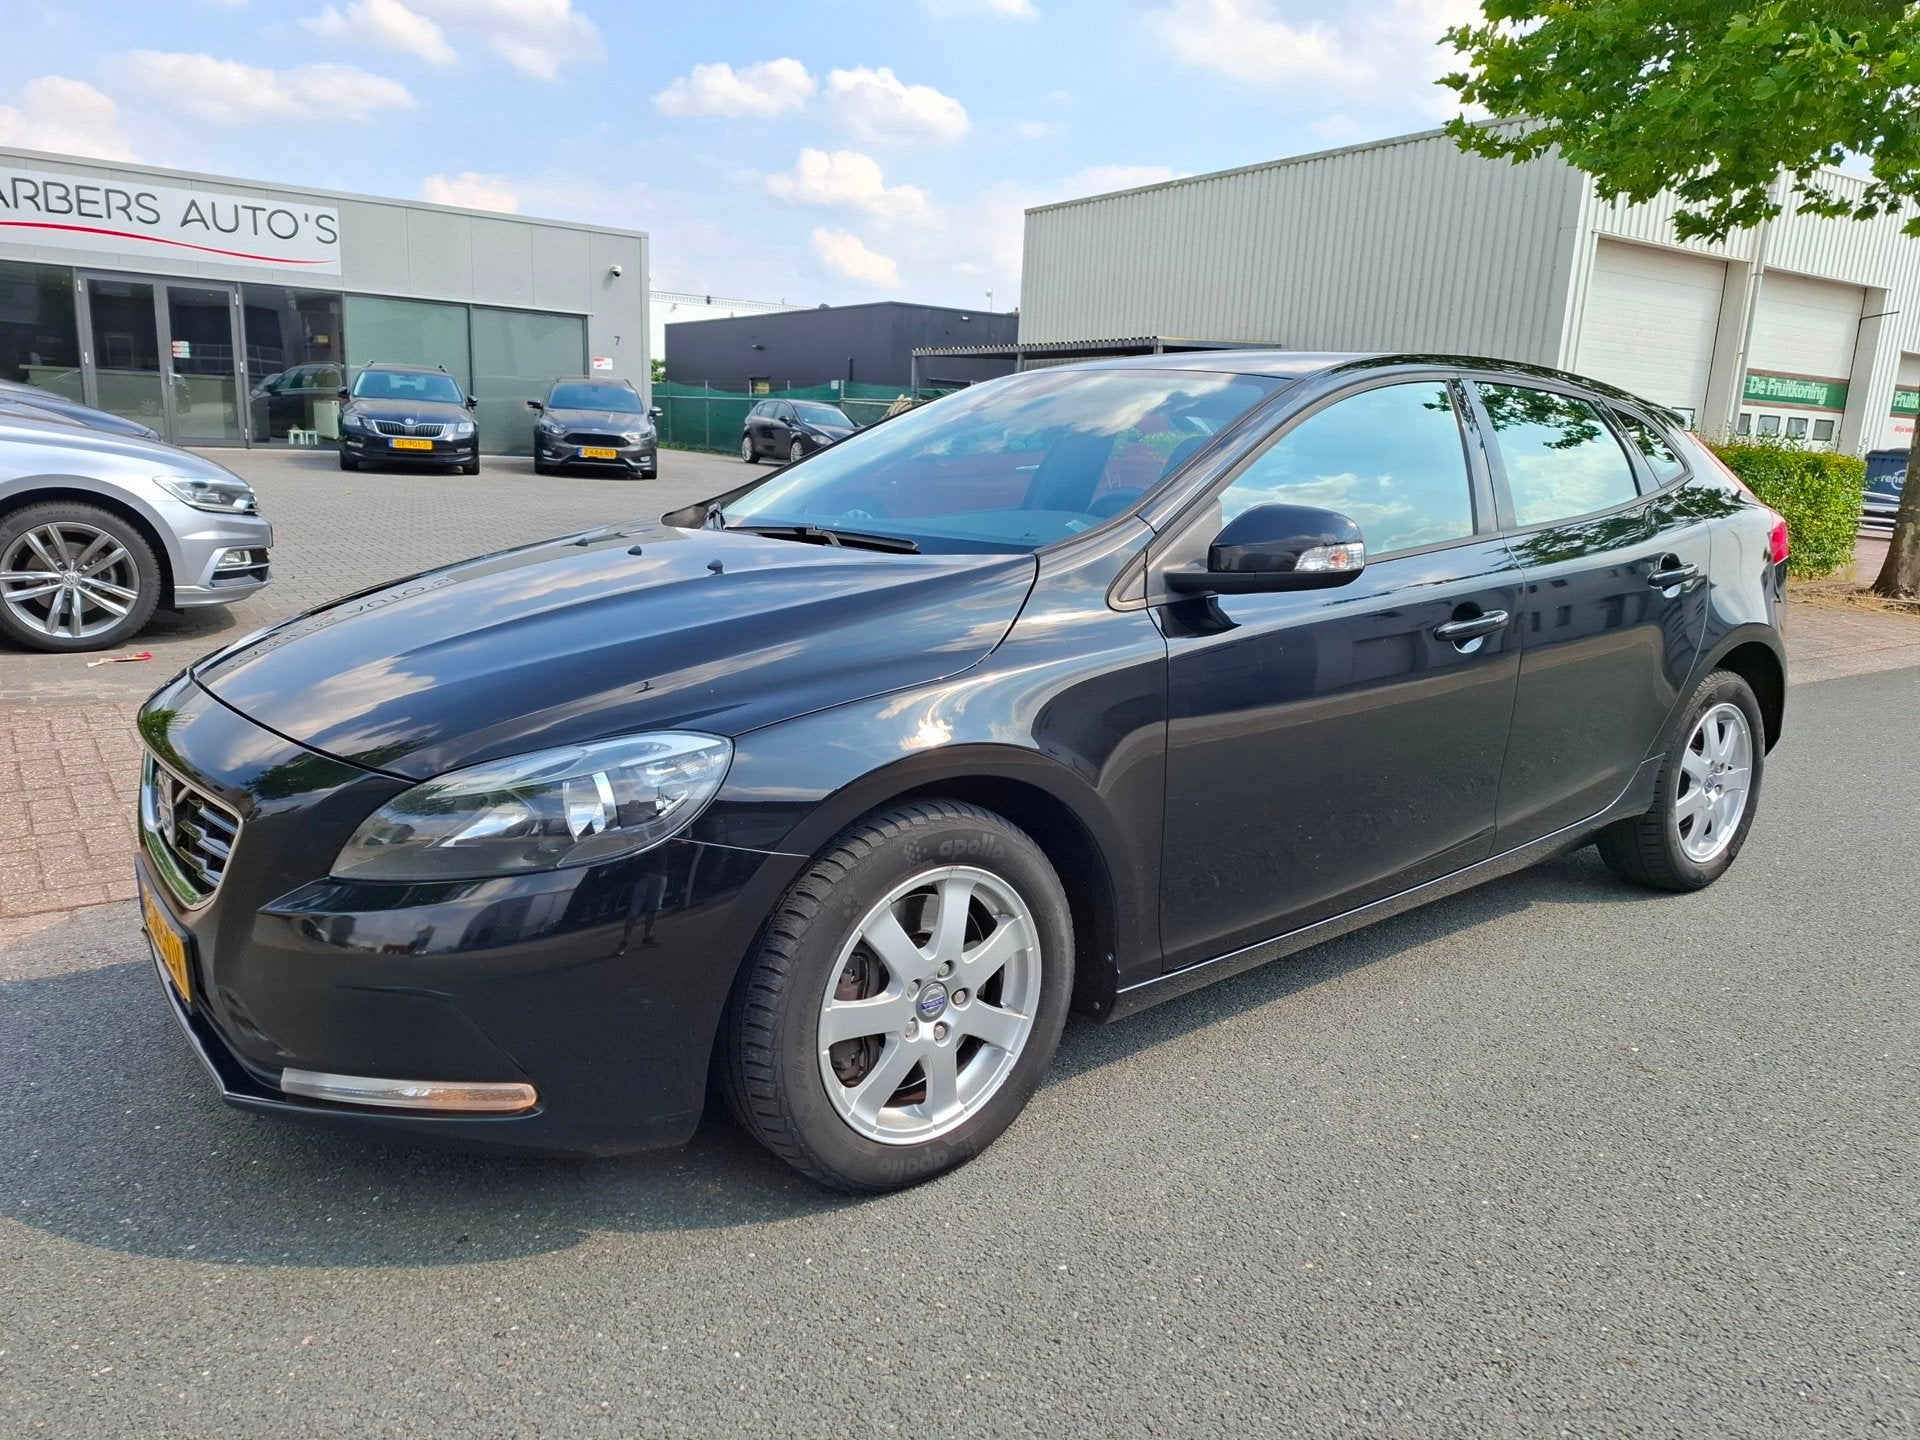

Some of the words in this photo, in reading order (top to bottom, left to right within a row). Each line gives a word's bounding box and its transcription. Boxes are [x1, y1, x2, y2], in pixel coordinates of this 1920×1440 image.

[180, 199, 337, 244] AUTO'S
[614, 335, 621, 346] 7
[1749, 376, 1766, 394] De
[1767, 378, 1827, 405] Fruitkoning
[939, 832, 1005, 860] apollo
